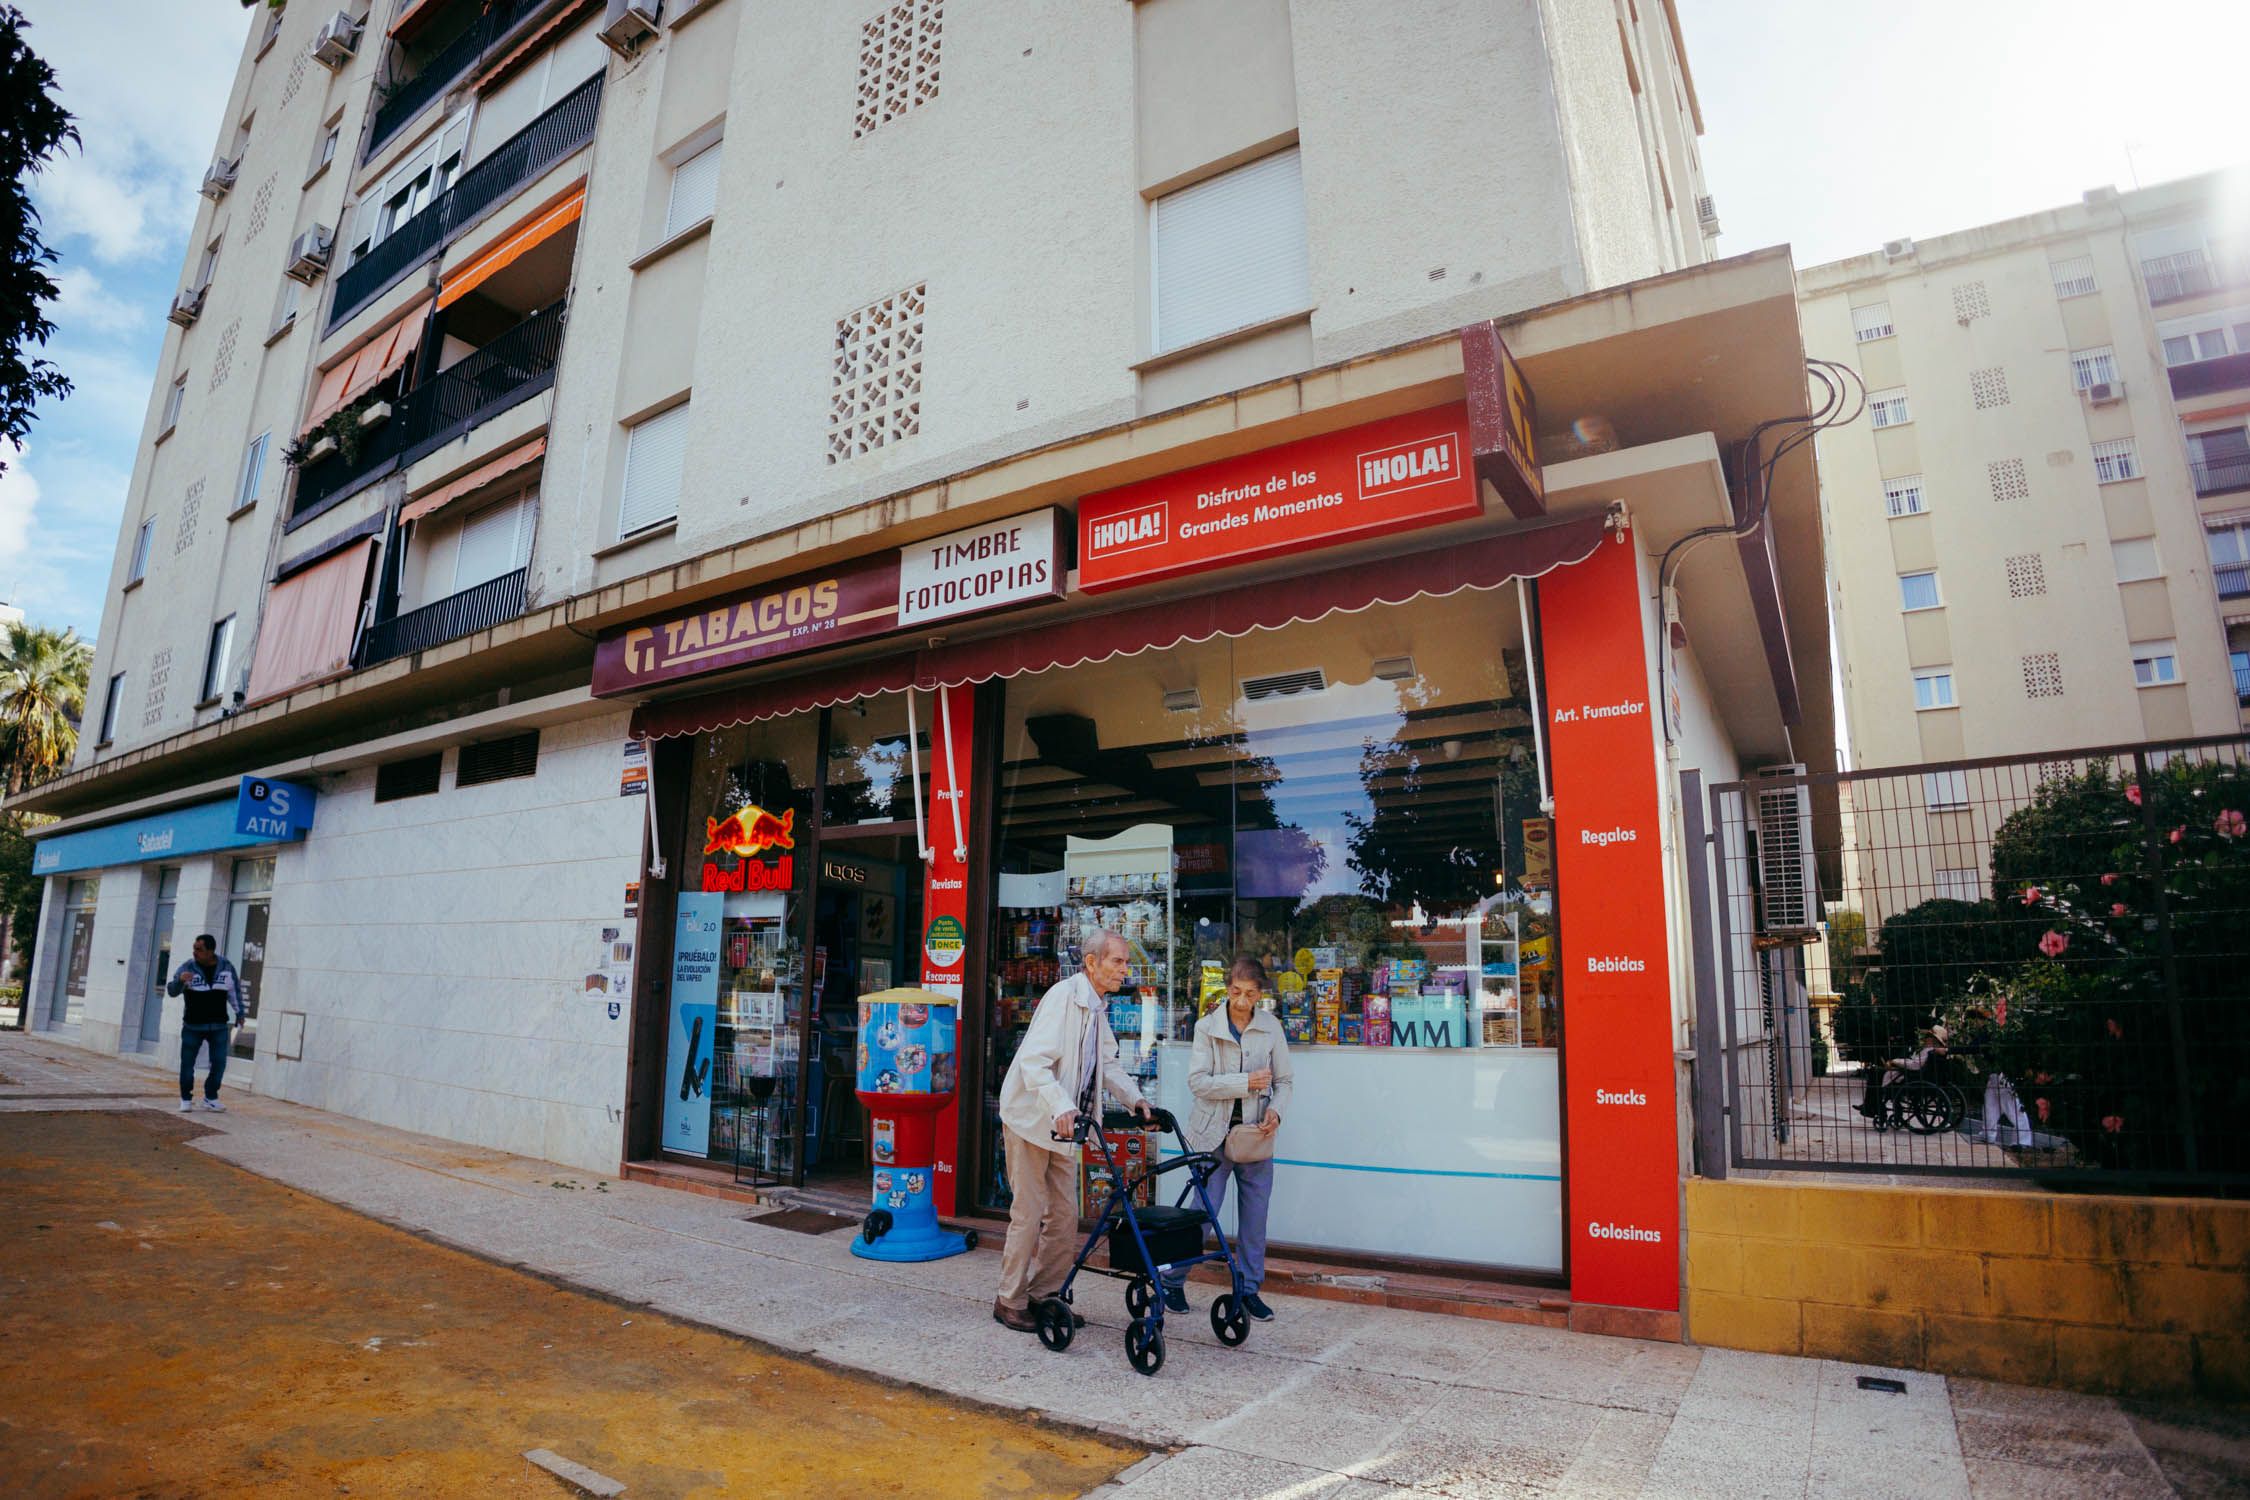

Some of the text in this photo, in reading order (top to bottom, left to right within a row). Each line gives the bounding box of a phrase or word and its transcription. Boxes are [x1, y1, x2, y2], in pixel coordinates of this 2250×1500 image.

[1364, 443, 1450, 488] ¡HOLA!
[1197, 469, 1317, 511] Disfruta de los
[1179, 488, 1344, 540] Grandes Momentos
[1094, 511, 1161, 550] ¡HOLA!
[931, 527, 1023, 571] TIMBRE
[904, 558, 1048, 614] FOTOCOPIAS
[664, 577, 840, 657] TABACOS
[792, 623, 809, 638] EXP.
[824, 618, 836, 631] 28
[1554, 699, 1644, 724] Art. Fumador
[937, 788, 964, 801] Prea
[246, 816, 287, 837] ATM
[1581, 827, 1637, 847] Regalos
[702, 854, 794, 892] Red Bull
[931, 878, 962, 890] Revistas
[703, 922, 717, 933] 2.0
[678, 948, 717, 962] ¡PRUÉBALO!
[936, 941, 961, 950] ONCE
[677, 965, 684, 973] LA
[1587, 956, 1645, 973] Bebidas
[676, 973, 686, 982] DEL
[926, 970, 961, 984] Recargas
[1596, 1088, 1646, 1106] Snacks
[938, 1161, 953, 1173] Bus
[1589, 1222, 1661, 1244] Golosinas
